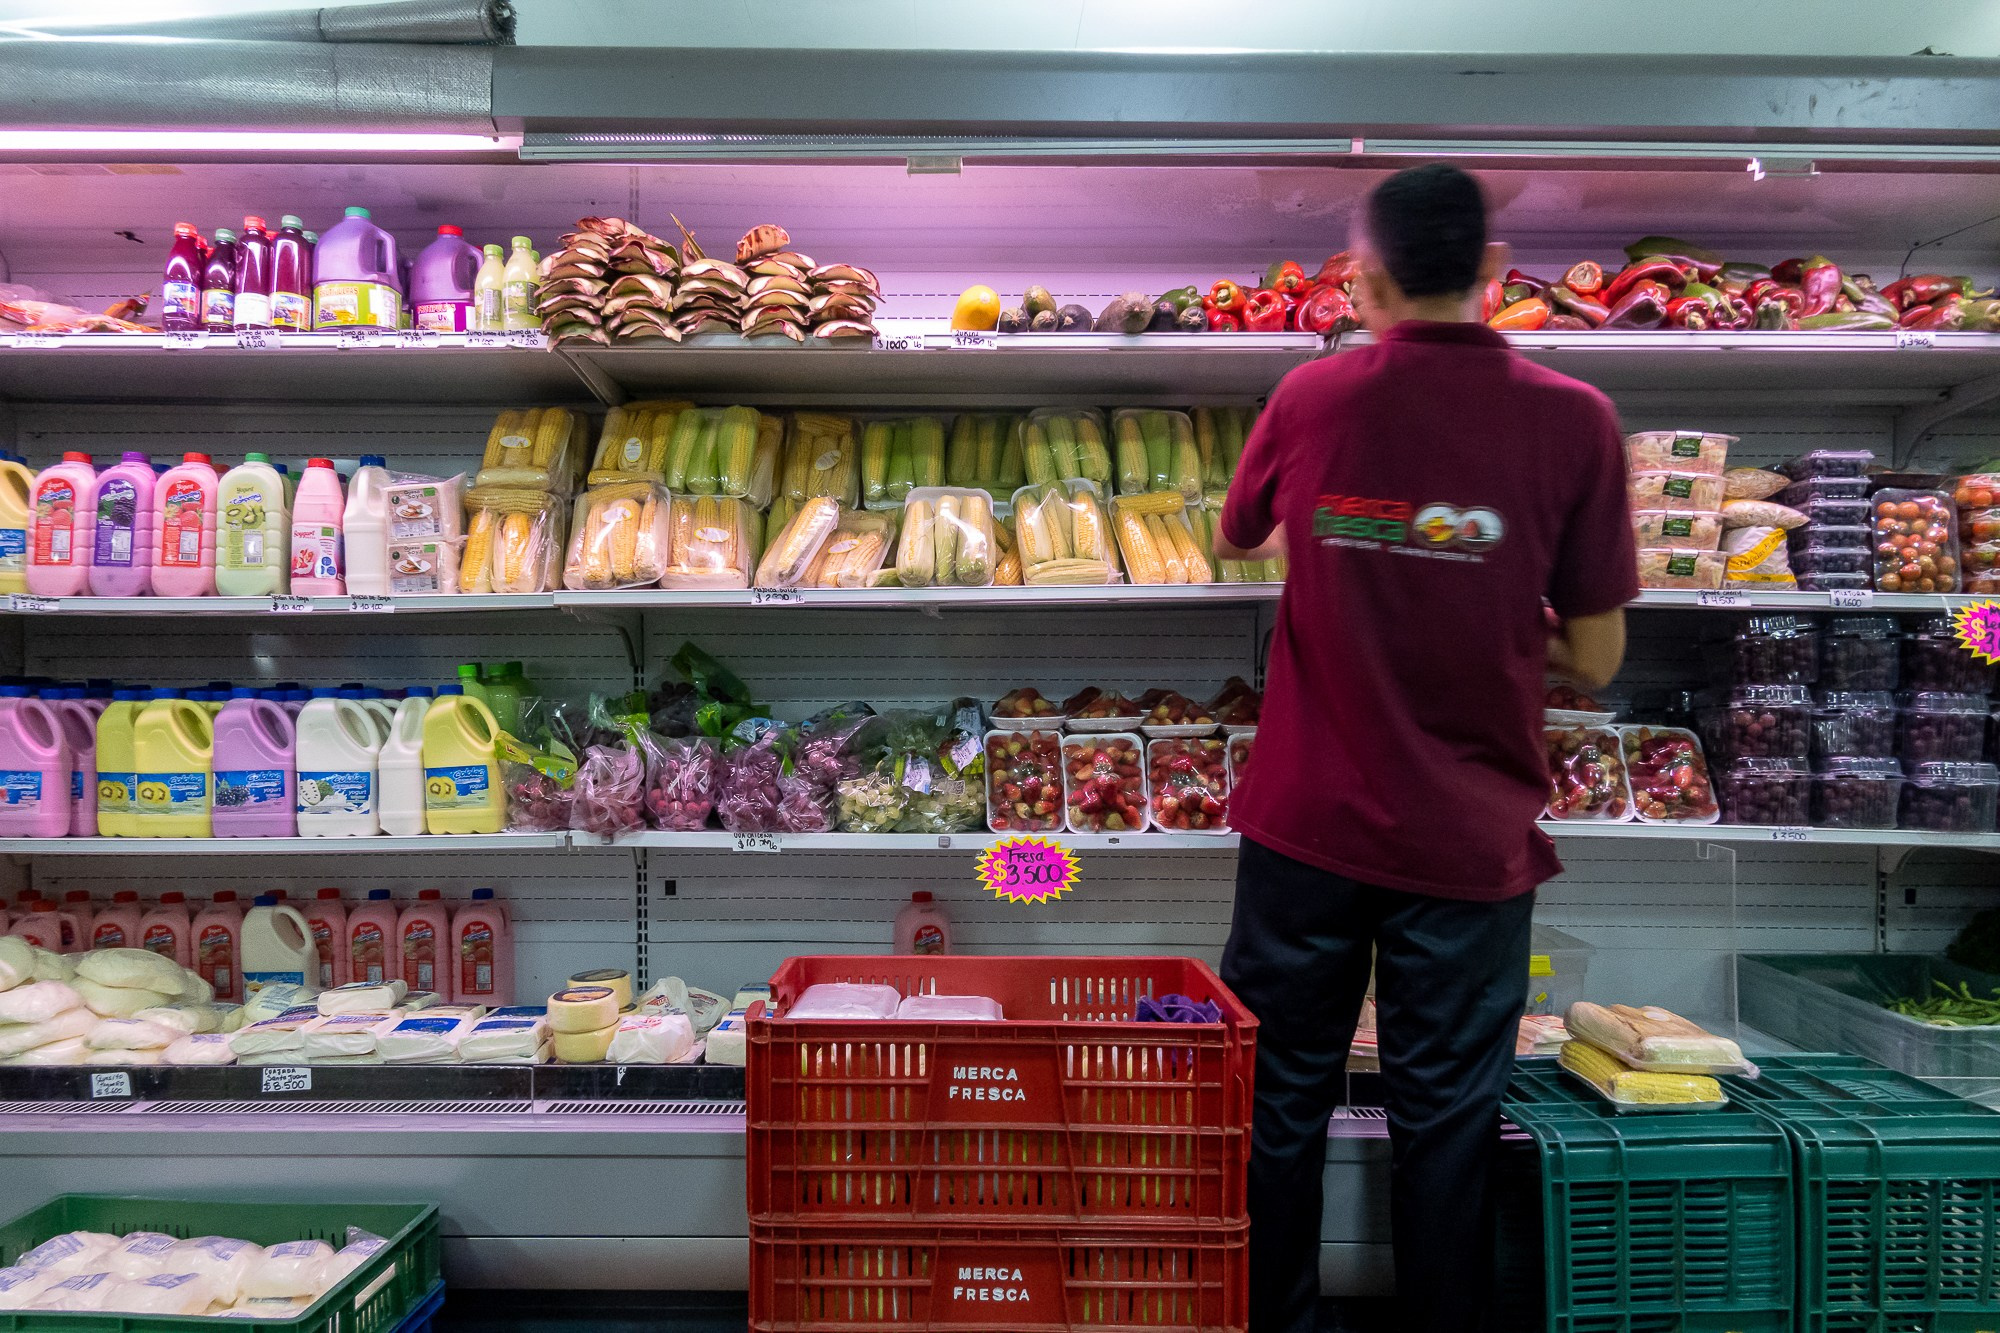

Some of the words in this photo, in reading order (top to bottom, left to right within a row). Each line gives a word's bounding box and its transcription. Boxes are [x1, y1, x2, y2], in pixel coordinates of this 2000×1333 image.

[953, 1067, 1018, 1081] MERCA
[949, 1086, 1026, 1101] FRESCA
[958, 1267, 1023, 1281] MERCA
[953, 1286, 1030, 1301] FRESCA
